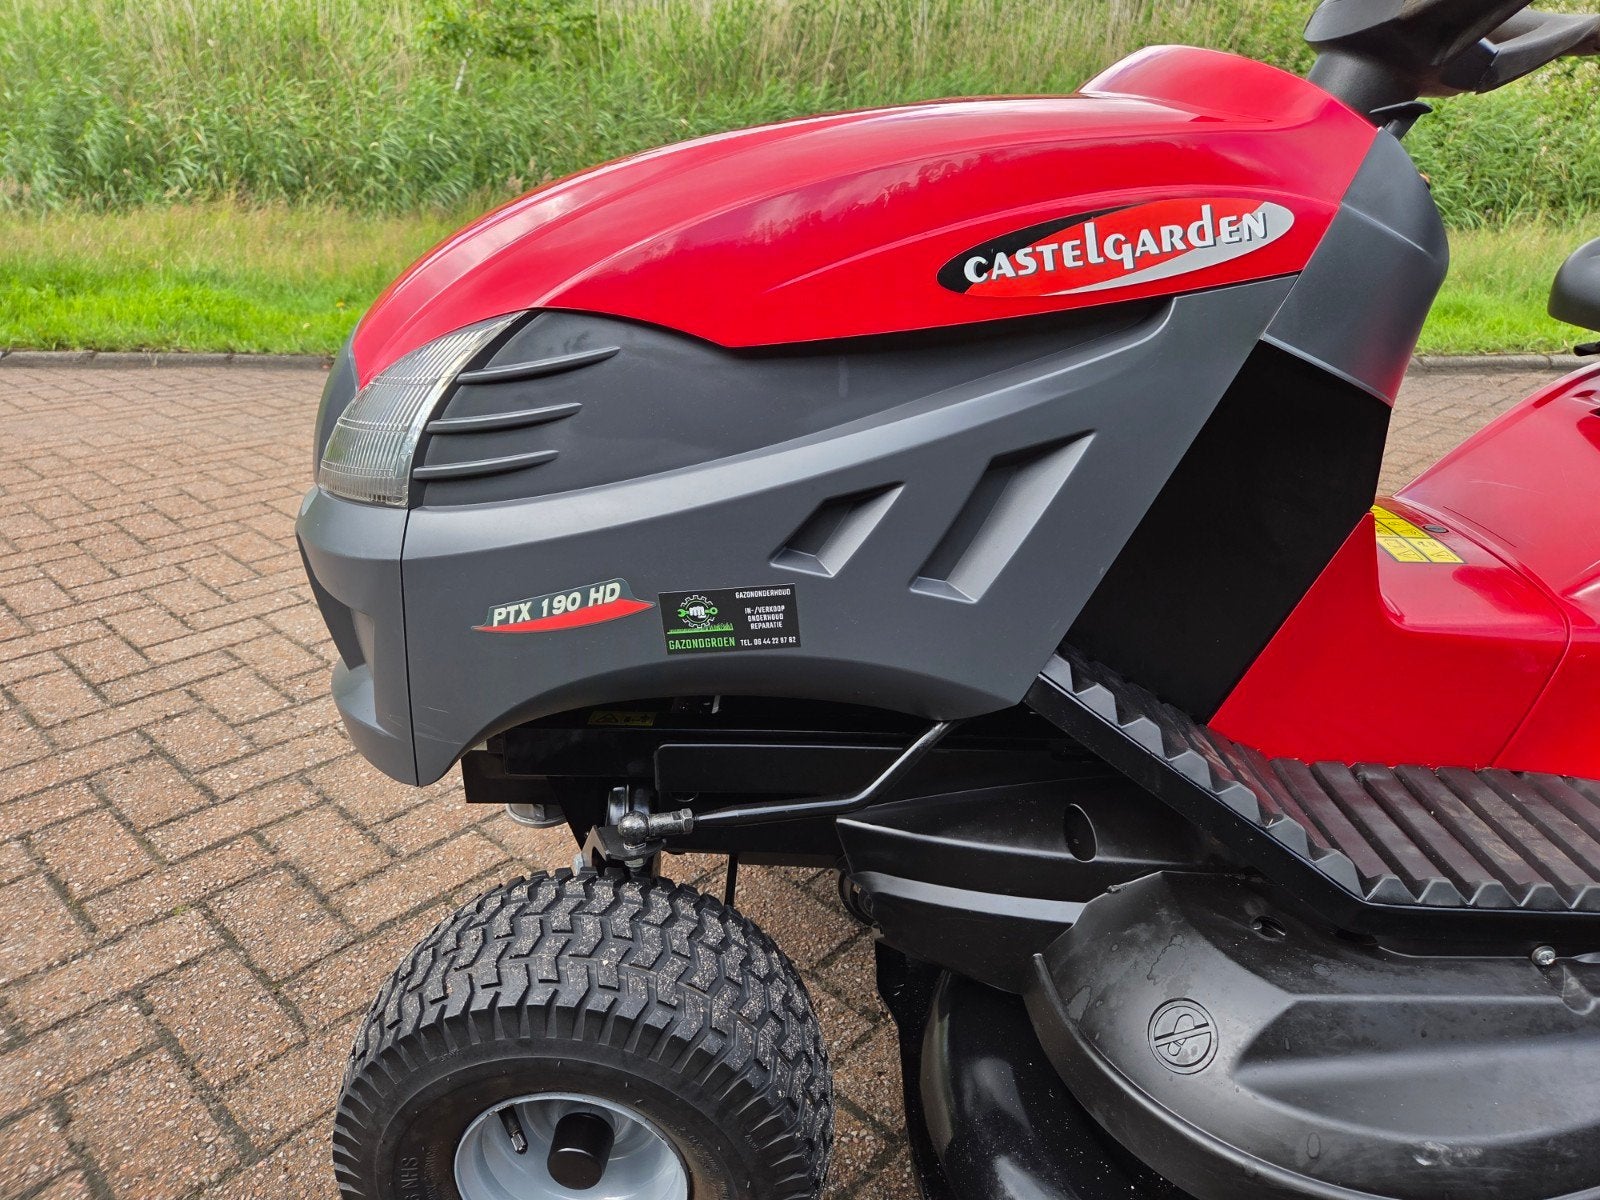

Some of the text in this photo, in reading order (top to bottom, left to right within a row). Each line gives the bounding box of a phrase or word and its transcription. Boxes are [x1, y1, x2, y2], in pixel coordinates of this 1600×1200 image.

[735, 588, 791, 599] GAZONONDERHOUD
[493, 582, 621, 627] PTX 190 HD
[747, 613, 784, 622] ONDERHOUD
[750, 621, 783, 630] REPARATIE
